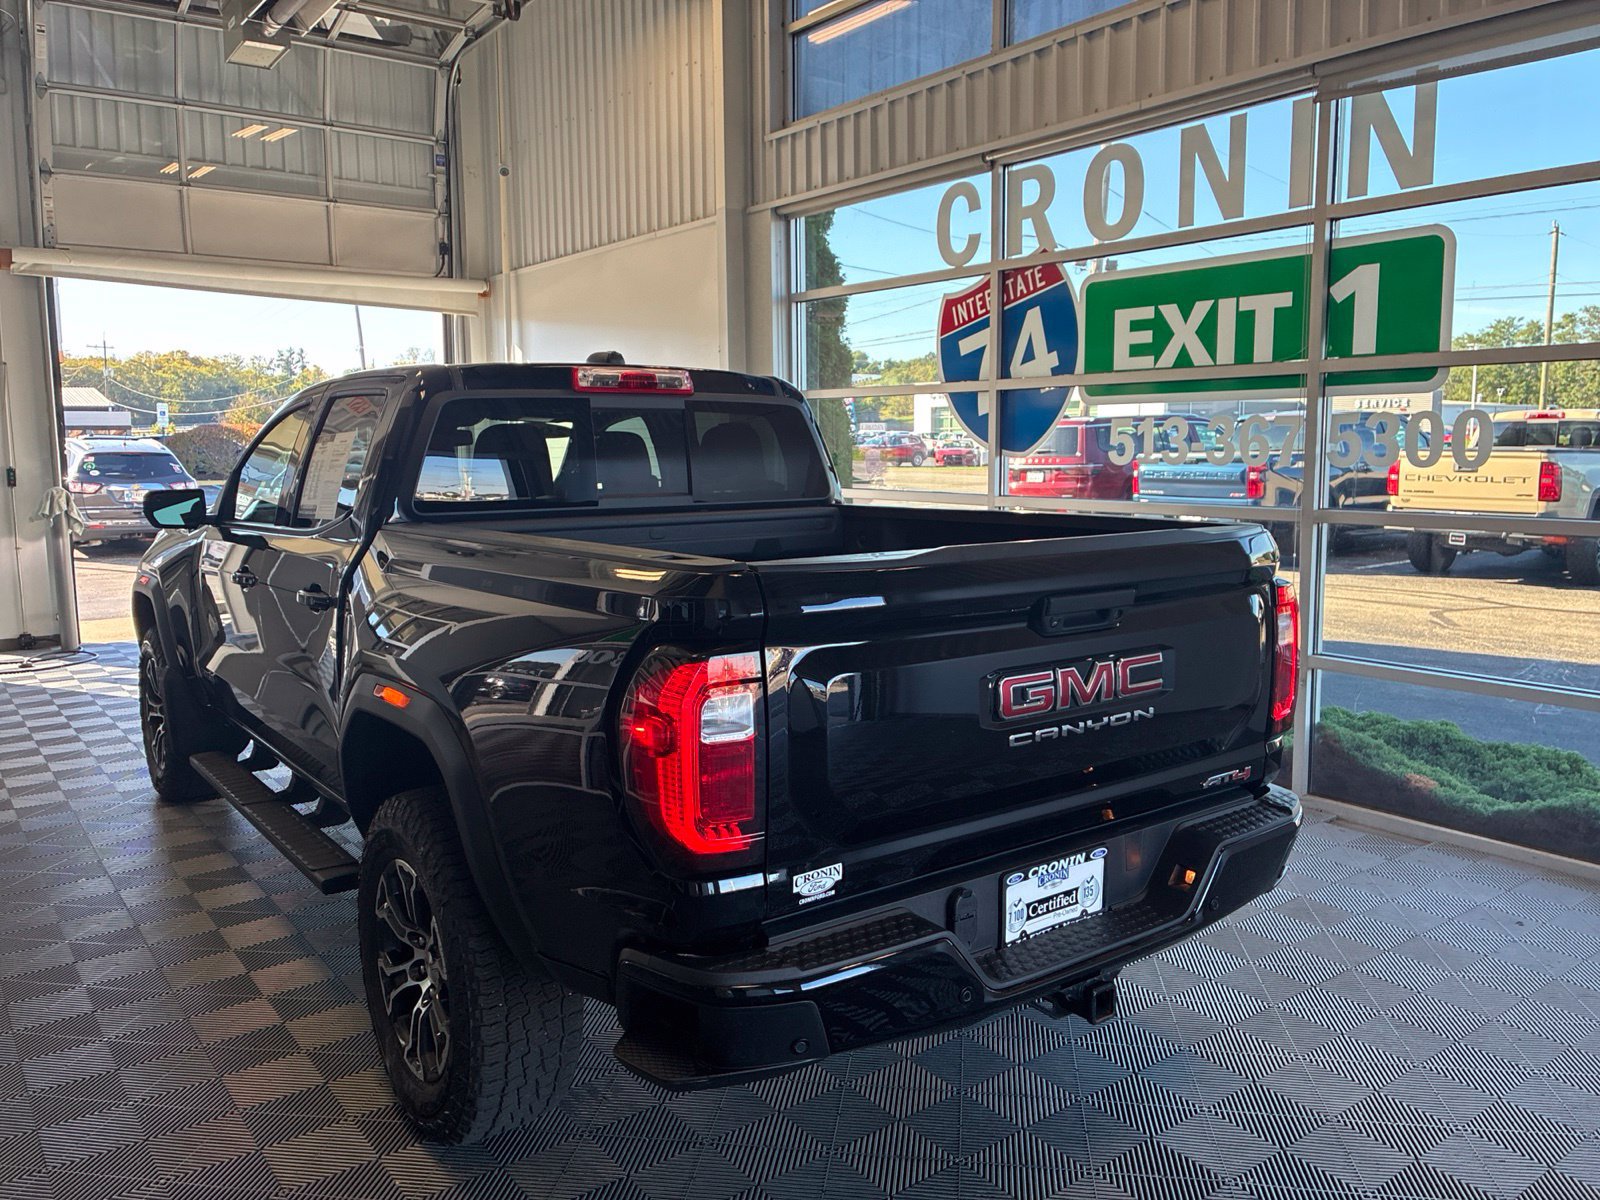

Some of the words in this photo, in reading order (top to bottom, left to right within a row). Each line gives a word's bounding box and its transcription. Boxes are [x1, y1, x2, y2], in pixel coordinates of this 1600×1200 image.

[936, 76, 1438, 268] CRONIN
[952, 265, 1047, 326] INTETATE
[1113, 291, 1293, 371] EXIT
[1329, 263, 1380, 355] 1
[958, 305, 1060, 416] 74
[1354, 398, 1411, 409] SERVICE
[1107, 409, 1494, 469] 513-3675300
[1405, 474, 1533, 484] CHEVROLET
[1000, 651, 1163, 719] GMC
[1009, 706, 1155, 747] CANYON
[1201, 766, 1252, 789] AT4
[795, 865, 841, 888] CRONIN
[1028, 852, 1087, 879] CRONIN
[808, 880, 828, 893] Ford
[1083, 885, 1094, 899] 135
[1029, 890, 1077, 917] Certified
